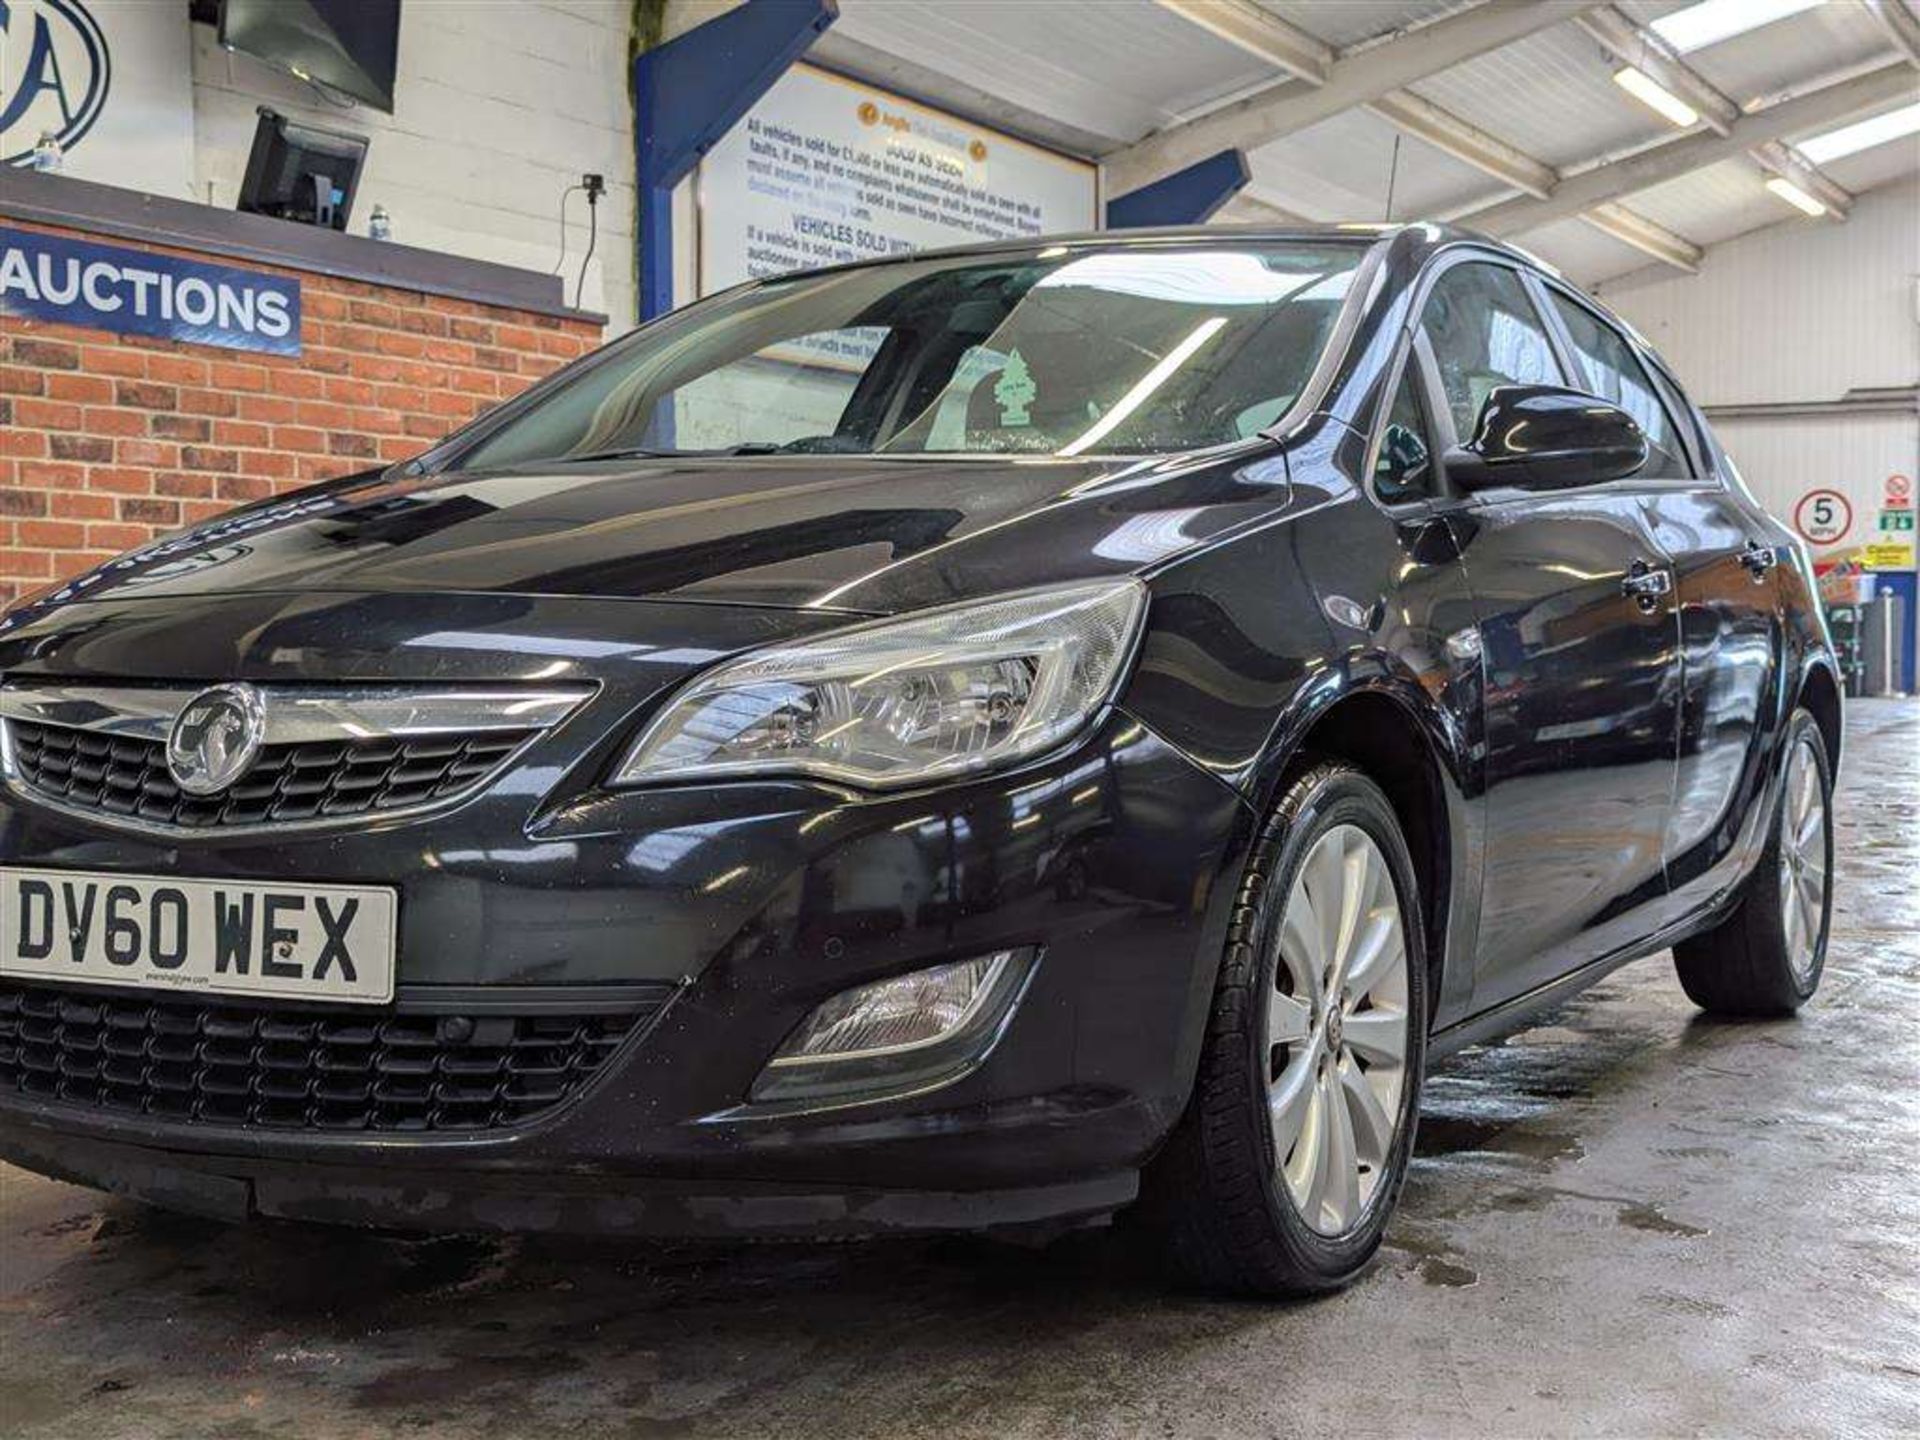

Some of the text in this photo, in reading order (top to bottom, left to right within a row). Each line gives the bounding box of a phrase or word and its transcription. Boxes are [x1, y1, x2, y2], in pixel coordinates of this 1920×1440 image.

[763, 124, 802, 148] vehicles
[805, 134, 825, 153] sold
[765, 230, 800, 251] vehicle
[812, 242, 833, 259] sold
[792, 212, 853, 245] VEHICLES
[855, 227, 888, 251] SOLD
[0, 248, 291, 337] AUCTIONS
[1814, 498, 1833, 525] 5
[17, 879, 359, 982] DV60 WEX
